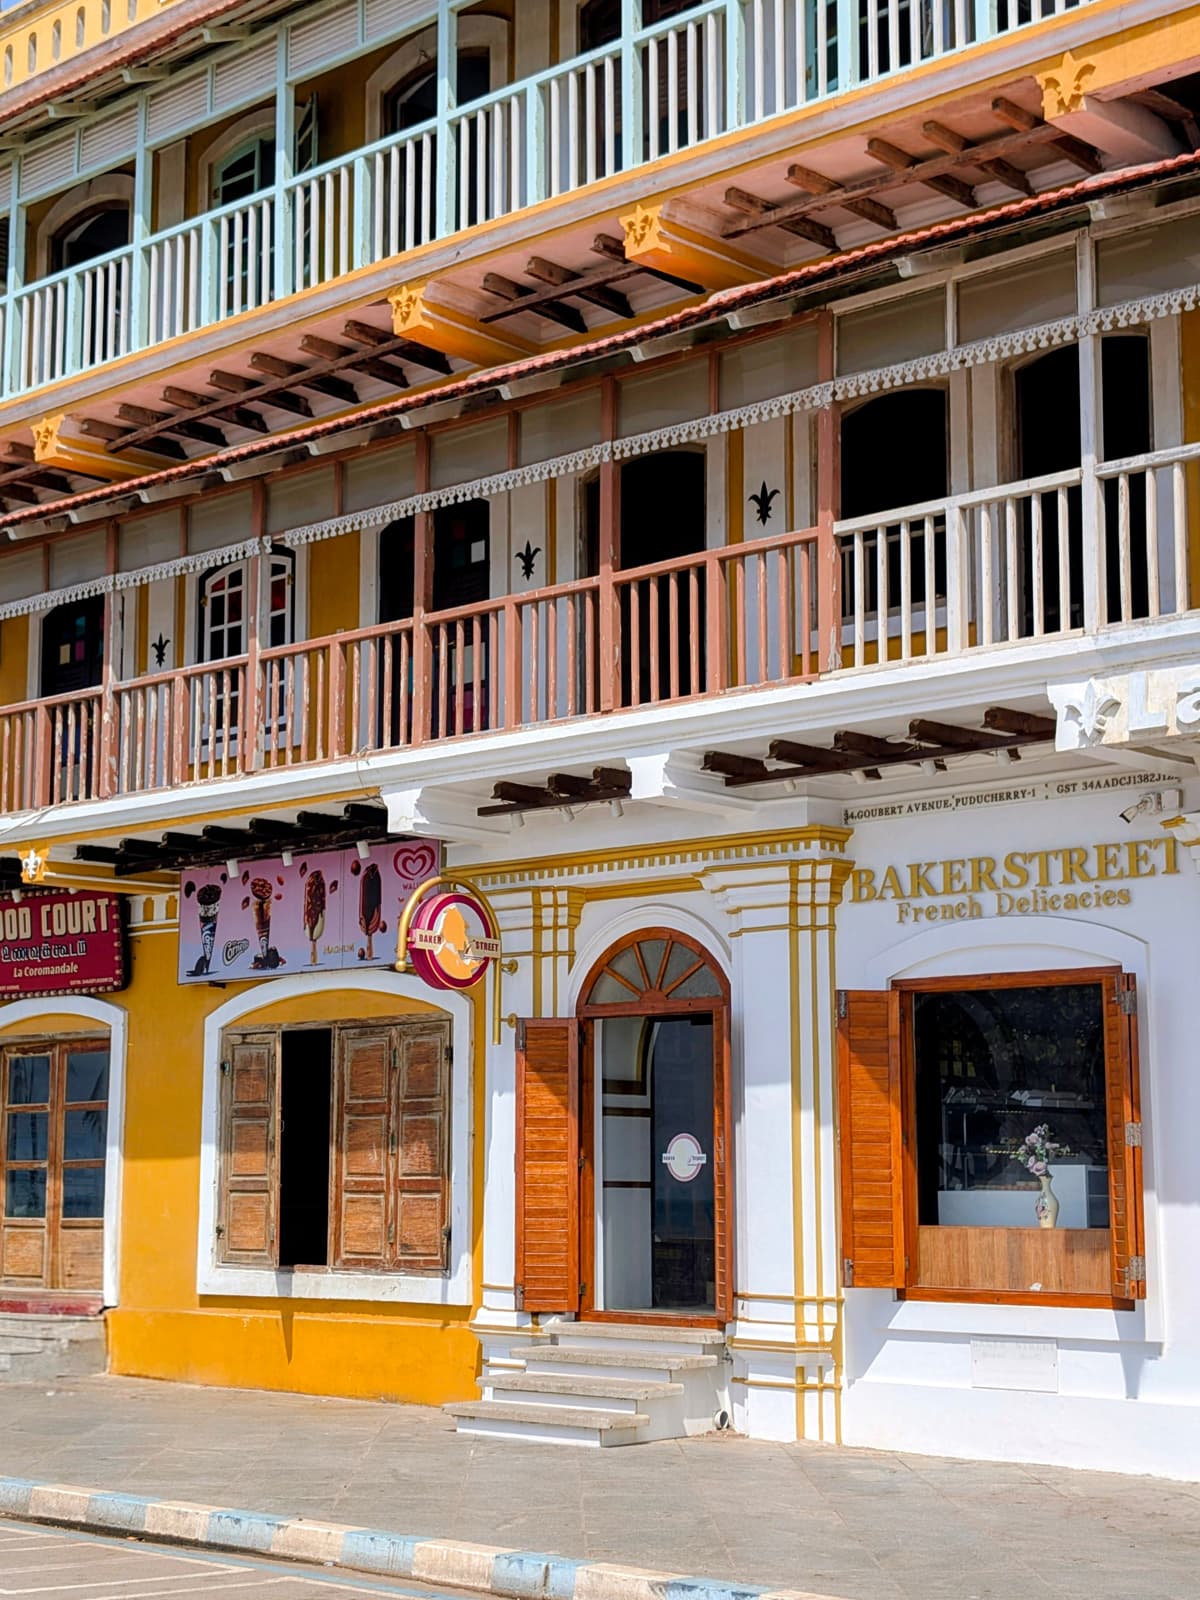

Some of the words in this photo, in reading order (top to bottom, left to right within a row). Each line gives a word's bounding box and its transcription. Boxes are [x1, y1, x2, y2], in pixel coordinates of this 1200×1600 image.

[955, 788, 1036, 807] PUDUCHERRY-1
[1056, 783, 1078, 794] GST
[896, 895, 983, 924] French
[995, 884, 1131, 915] Delicacies
[41, 898, 109, 937] COURT
[419, 934, 442, 945] BAKER
[475, 941, 500, 953] STREET
[13, 967, 23, 978] La
[24, 962, 78, 976] Coromandale
